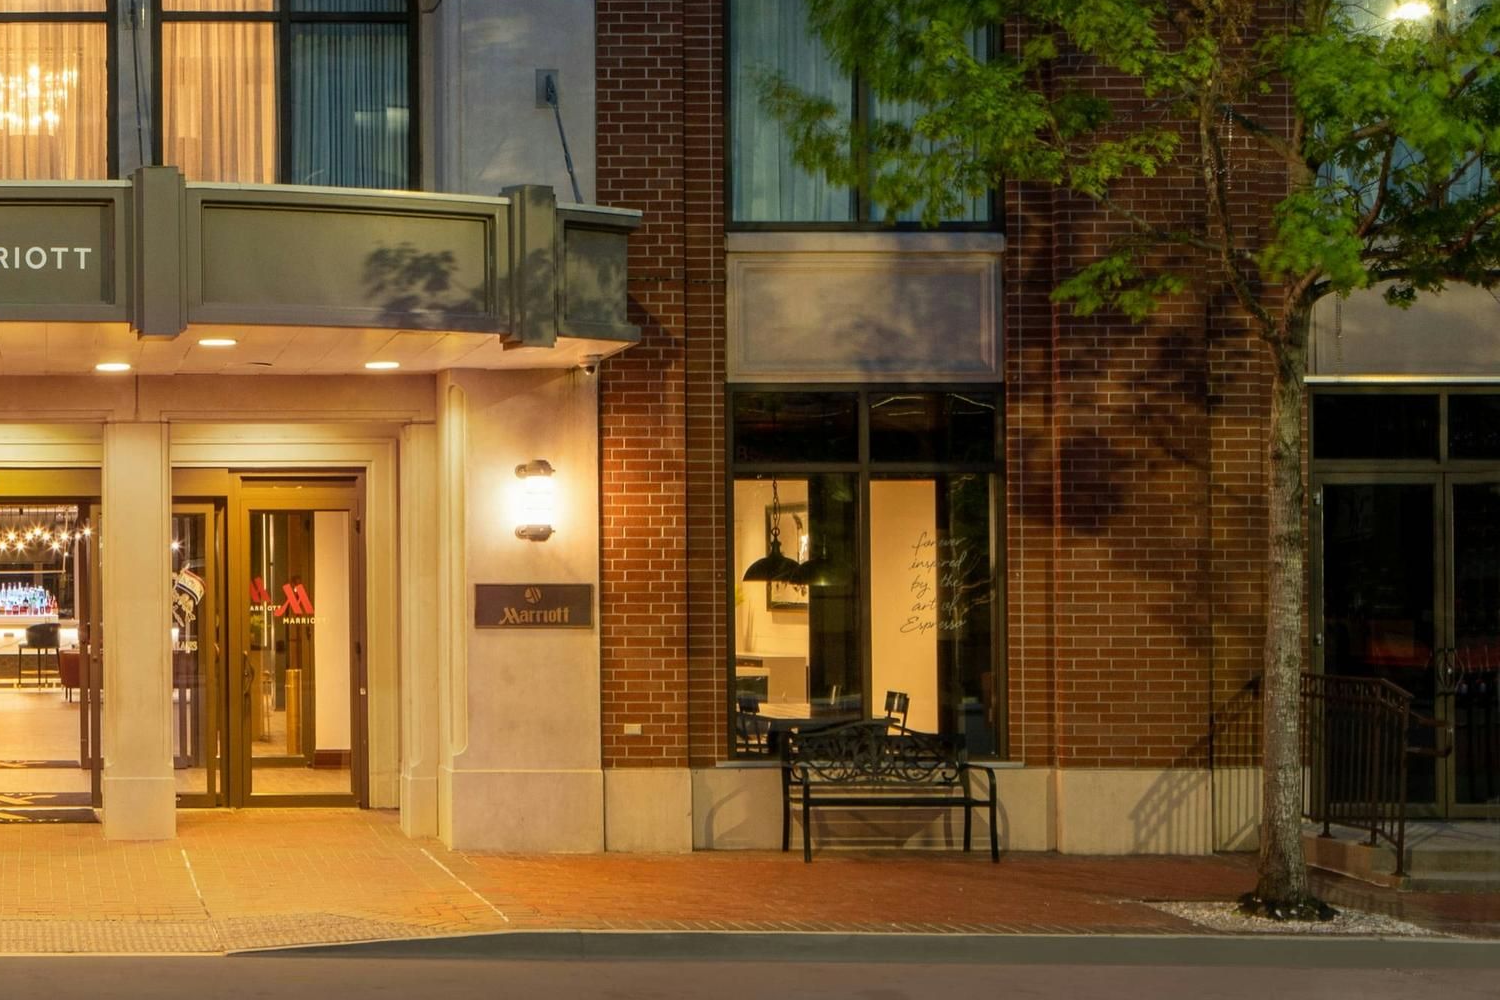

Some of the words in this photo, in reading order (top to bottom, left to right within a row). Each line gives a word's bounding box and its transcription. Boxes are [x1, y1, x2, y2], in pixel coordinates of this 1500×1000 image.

[911, 575, 931, 599] by
[912, 597, 938, 612] art
[498, 606, 570, 625] Marriott
[900, 616, 967, 635] Espresso
